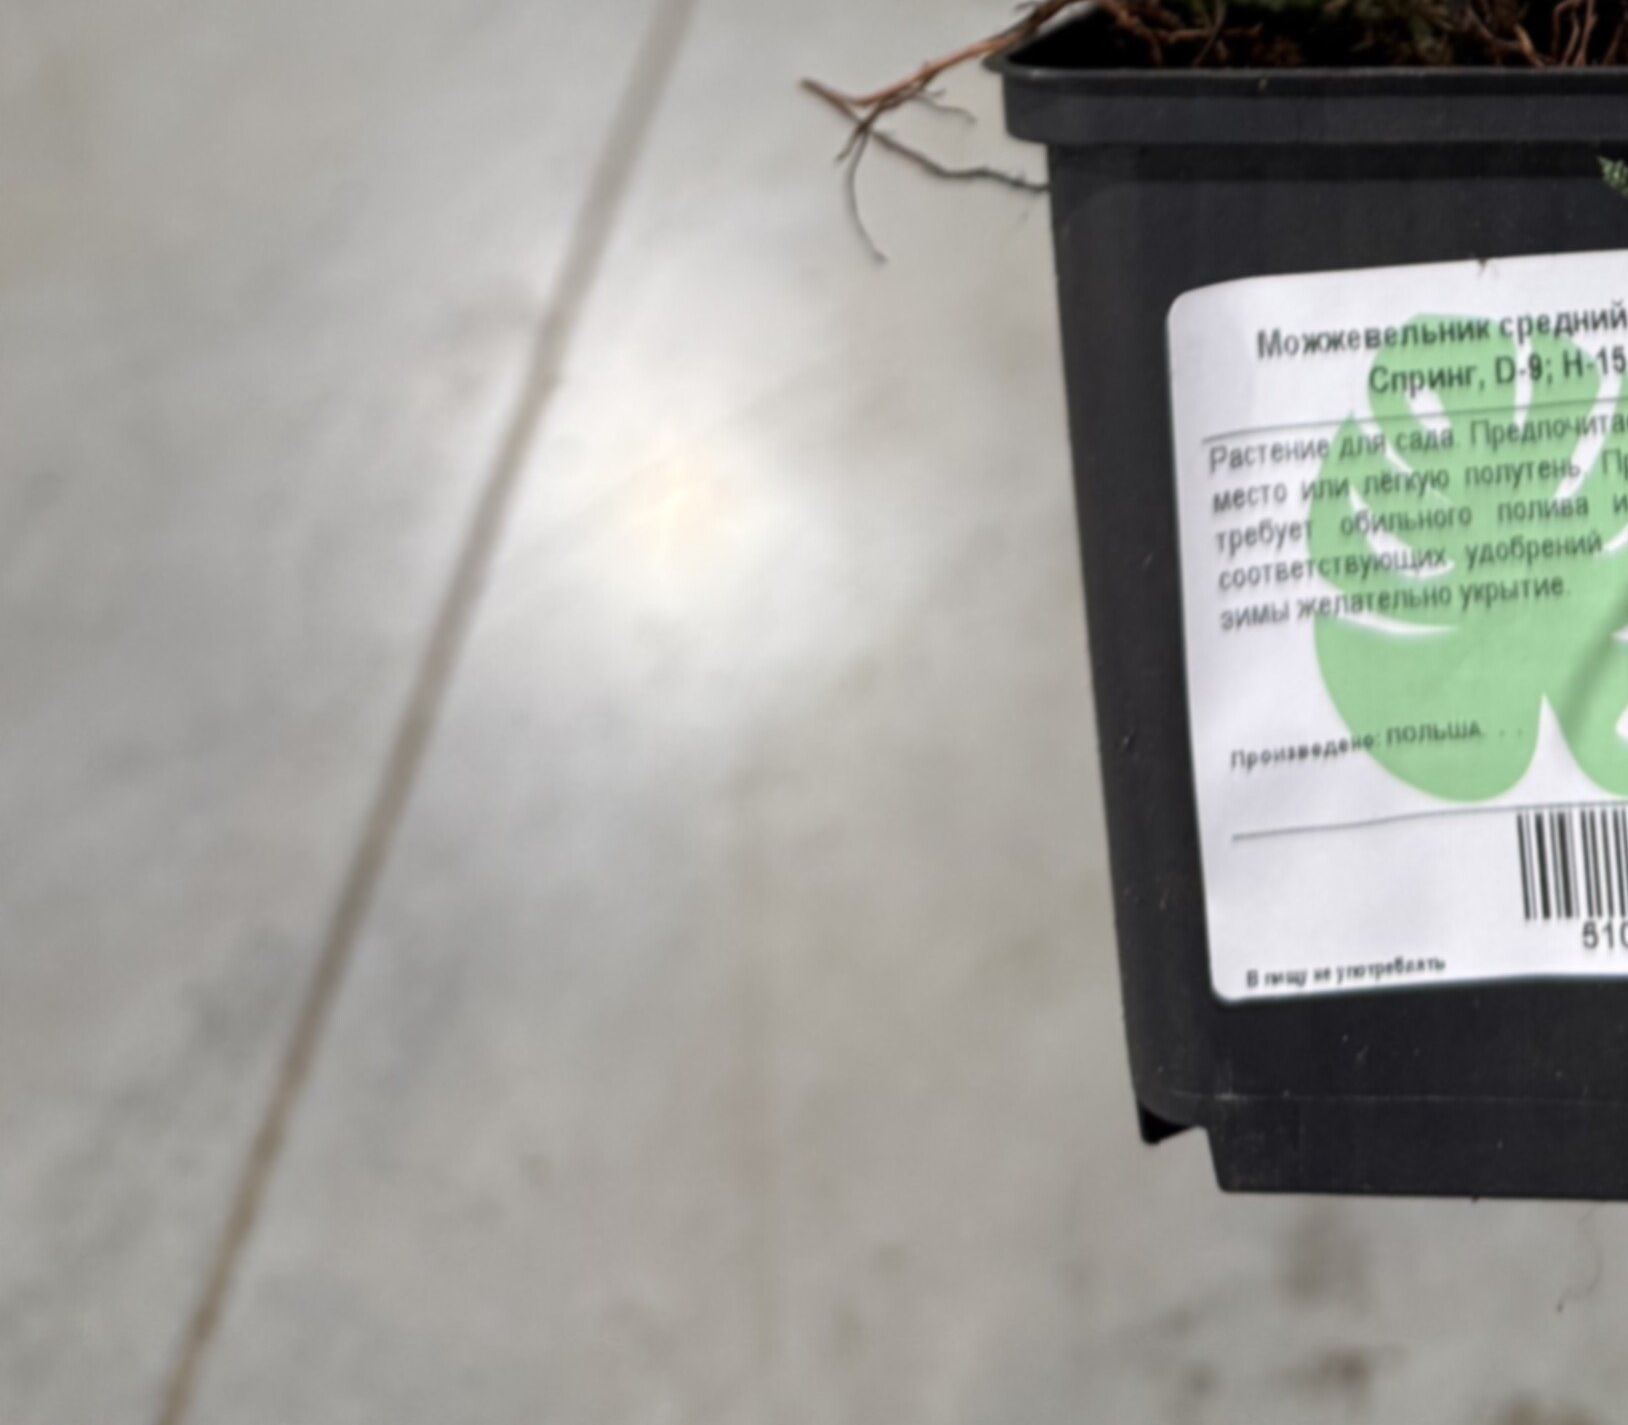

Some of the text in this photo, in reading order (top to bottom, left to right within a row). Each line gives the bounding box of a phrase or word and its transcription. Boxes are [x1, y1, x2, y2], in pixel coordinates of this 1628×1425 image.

[1257, 315, 1492, 362] Можжевельник
[1500, 300, 1627, 345] средний
[1369, 363, 1486, 398] Спринг,
[1495, 353, 1554, 386] D-9;
[1209, 438, 1330, 474] Растение
[1339, 431, 1387, 462] для
[1213, 483, 1288, 513] место
[1302, 476, 1352, 501] или
[1364, 463, 1450, 498] лёгкую
[1217, 518, 1313, 559] требует
[1340, 504, 1474, 540] обильного
[1498, 494, 1590, 526] полива
[1218, 550, 1448, 594] соответствующих
[1219, 598, 1291, 634] зимы
[1297, 581, 1454, 623] желательно
[1246, 955, 1446, 989] В пищу не употреблять
